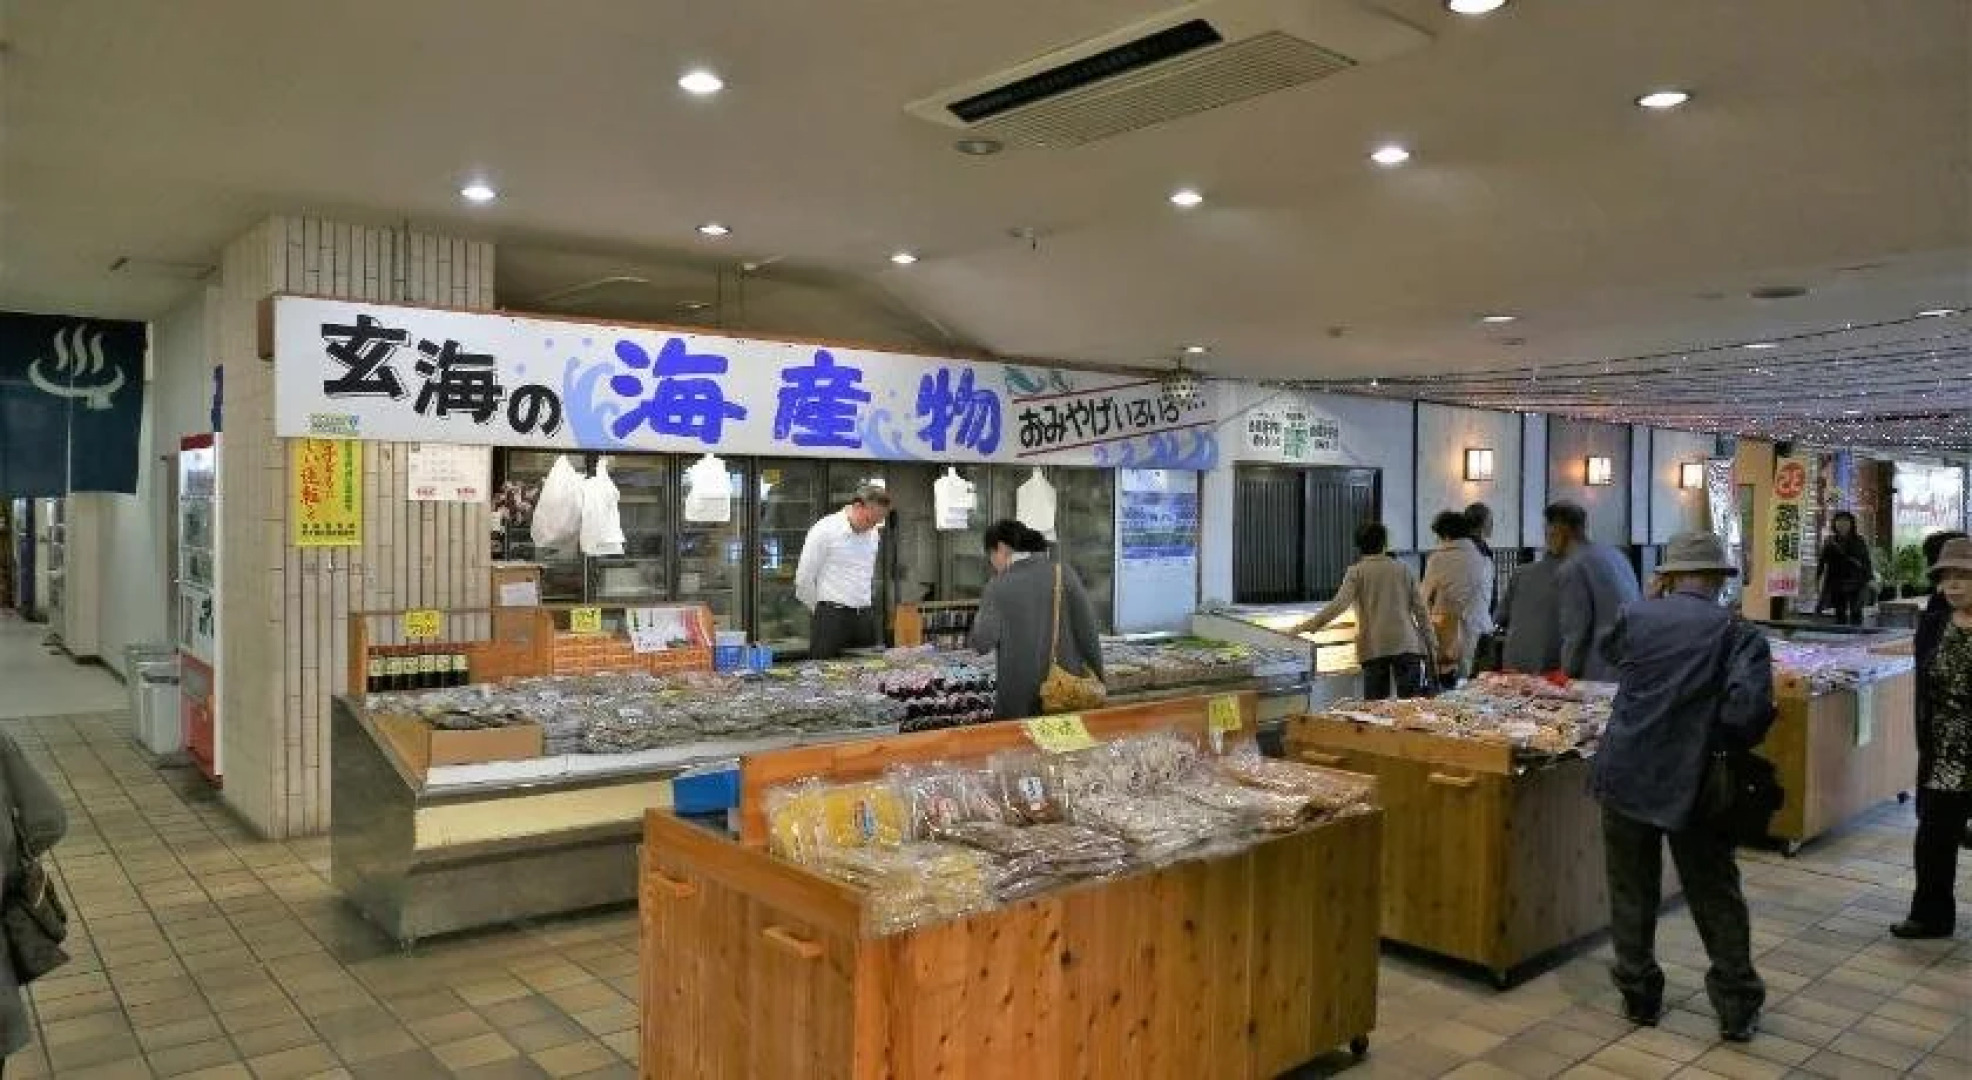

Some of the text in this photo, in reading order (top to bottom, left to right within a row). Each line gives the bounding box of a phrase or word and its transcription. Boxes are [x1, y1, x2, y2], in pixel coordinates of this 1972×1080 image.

[321, 314, 1000, 455] 玄海の 海産物
